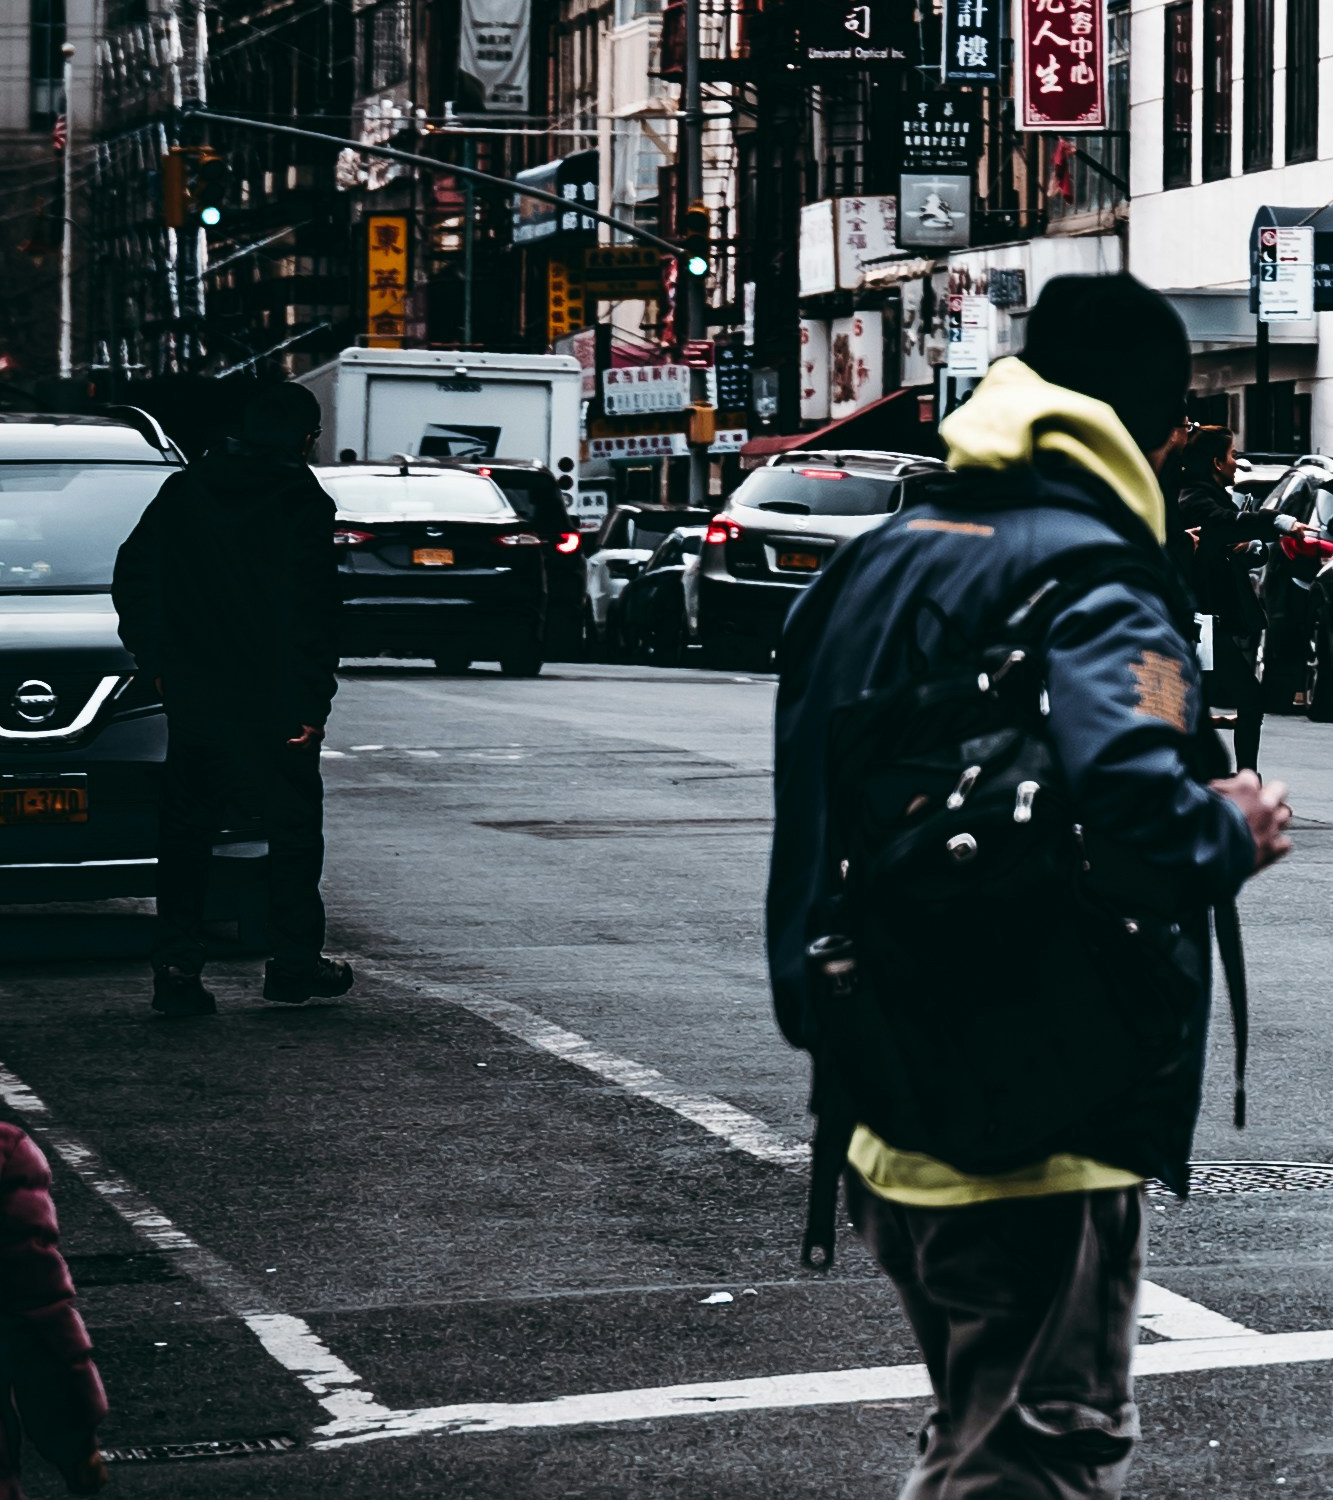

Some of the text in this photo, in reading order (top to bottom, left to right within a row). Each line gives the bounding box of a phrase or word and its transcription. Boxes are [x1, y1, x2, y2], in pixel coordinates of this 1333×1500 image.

[808, 47, 851, 59] Universal
[854, 47, 888, 60] Optical
[1264, 266, 1274, 281] 2
